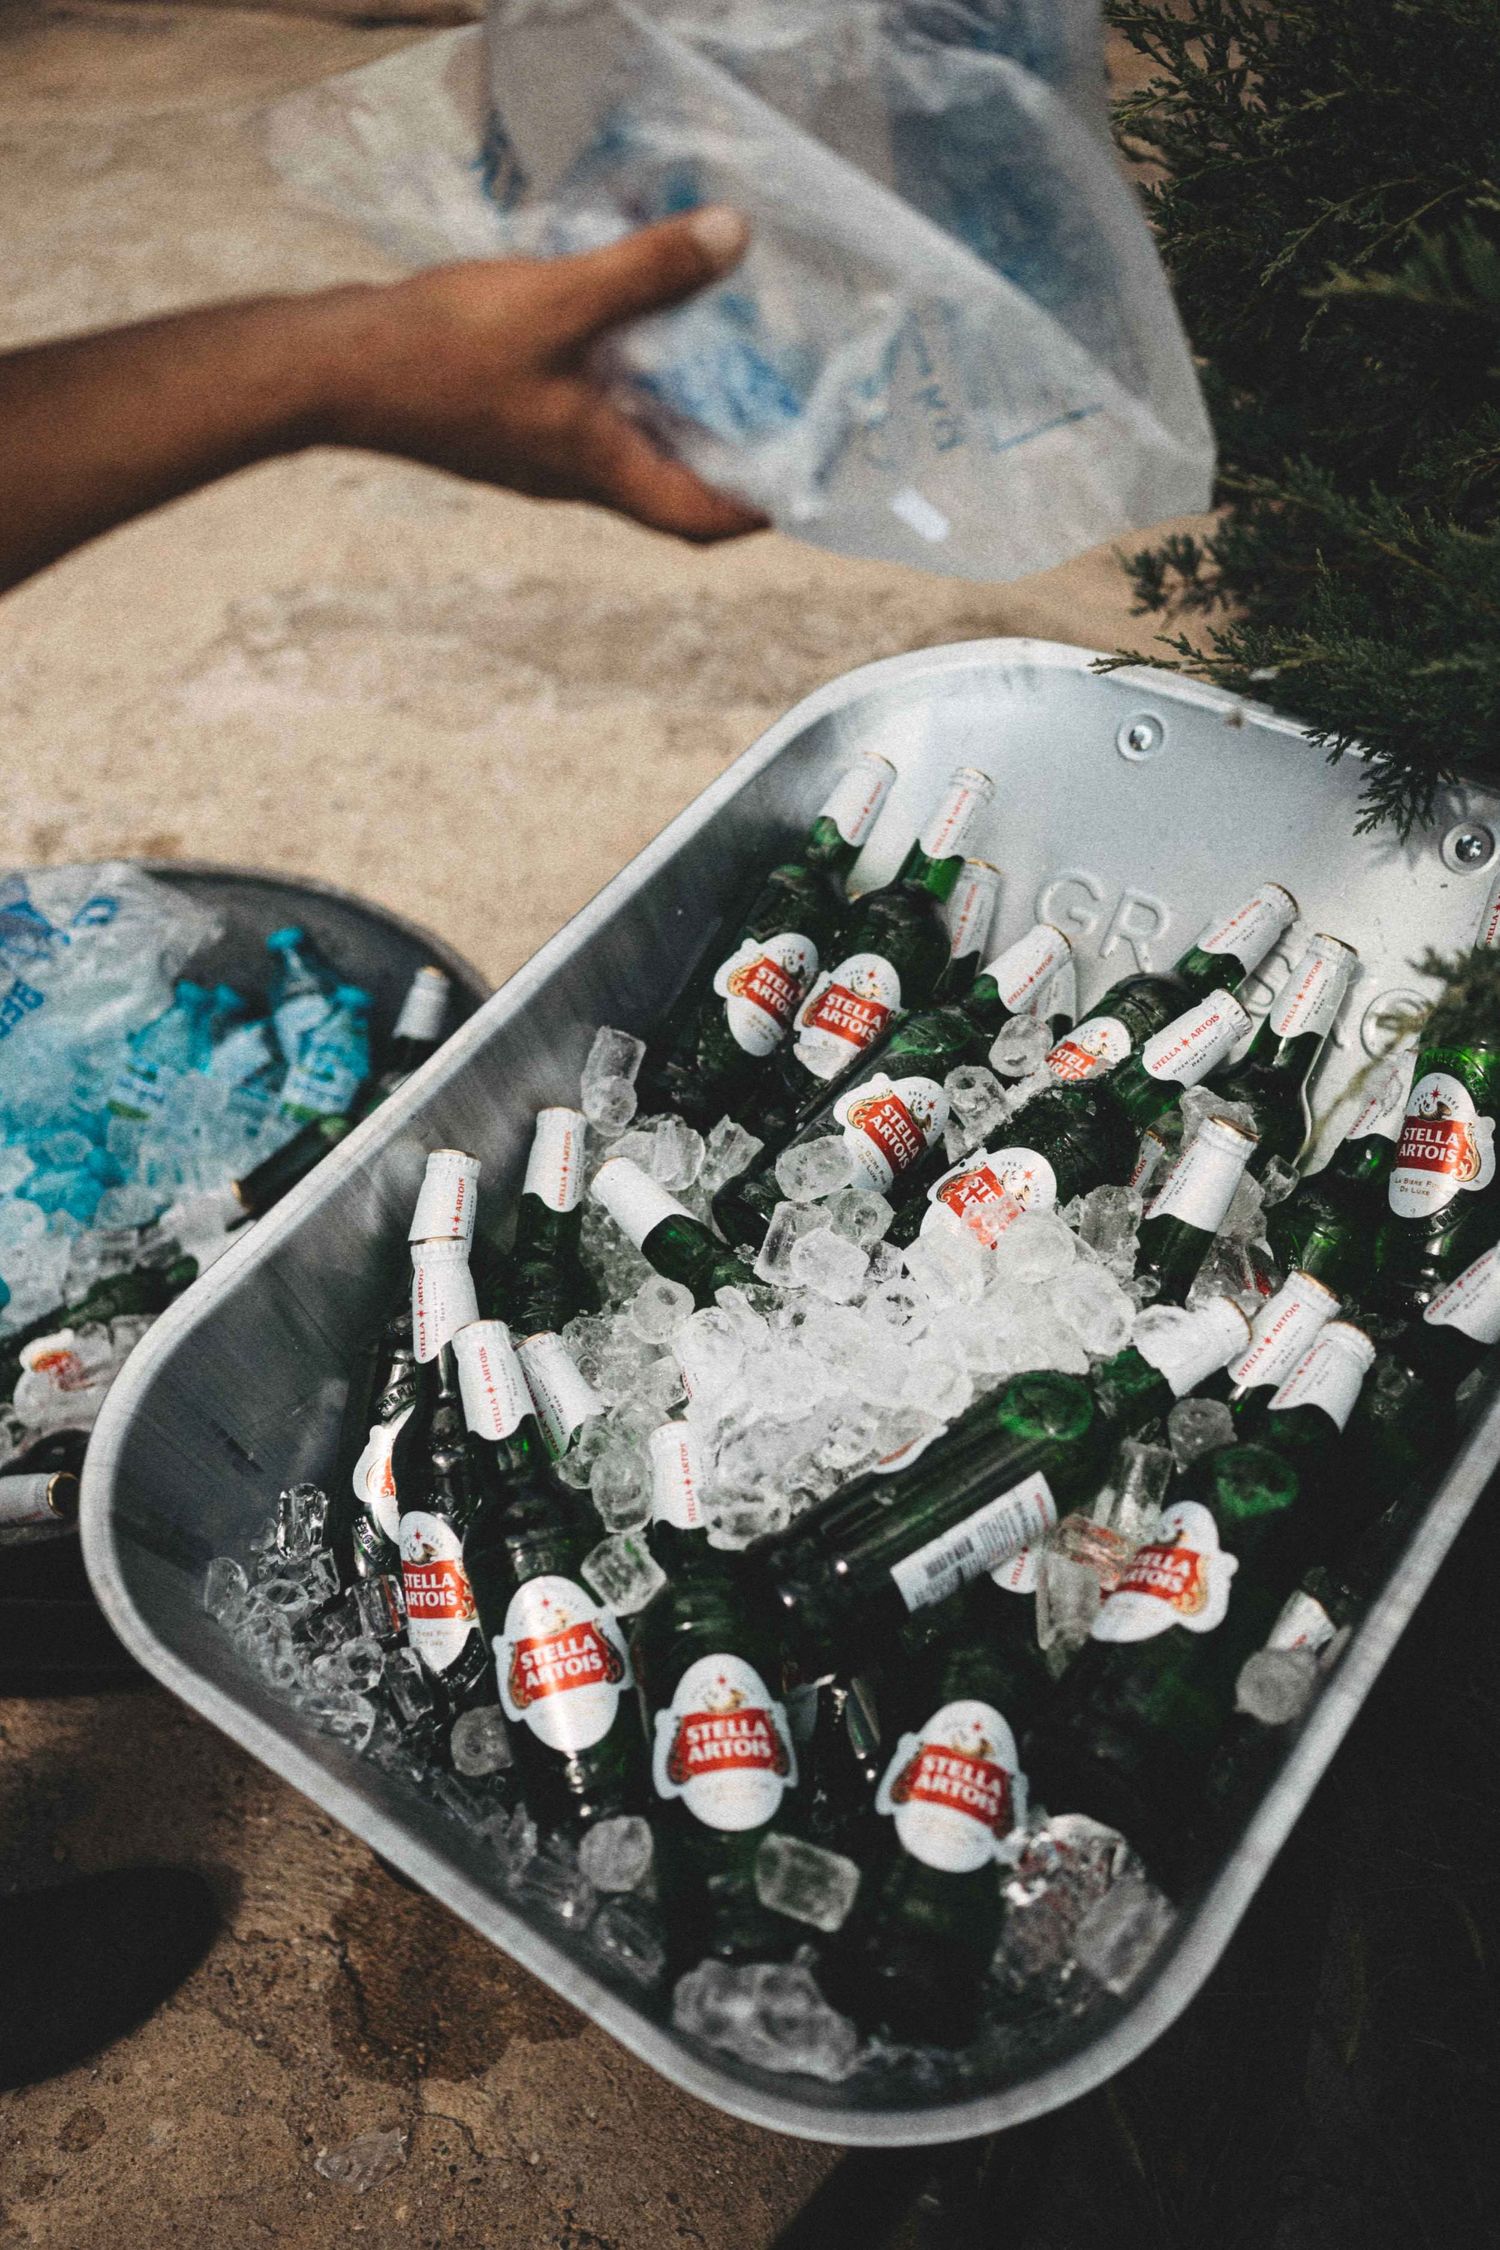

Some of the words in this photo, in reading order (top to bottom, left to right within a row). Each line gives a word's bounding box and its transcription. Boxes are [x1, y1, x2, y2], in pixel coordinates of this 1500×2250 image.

[825, 993, 881, 1028] STELLA
[1280, 1003, 1300, 1033] STELLA
[1302, 960, 1323, 991] ARTOIS
[817, 1008, 878, 1042] ARTOIS
[1152, 1045, 1182, 1072] STELLA
[1190, 1013, 1221, 1041] ARTOIS
[869, 1116, 910, 1170] ARTOIS
[879, 1103, 921, 1161] STELLA
[1404, 1127, 1459, 1146] STELLA
[1398, 1143, 1459, 1163] ARTOIS
[456, 1177, 465, 1213] ARTOIS
[559, 1176, 568, 1207] STELLA
[419, 1322, 427, 1358] STELLA
[1238, 1346, 1265, 1379] STELLA
[1271, 1302, 1301, 1335] ARTOIS
[479, 1346, 493, 1382] ARTOIS
[490, 1398, 504, 1434] STELLA
[520, 1633, 598, 1671] STELLA
[525, 1651, 603, 1690] ARTOIS
[685, 1718, 768, 1744] STELLA
[687, 1738, 772, 1764] ARTOIS
[913, 1773, 1000, 1816] ARTOIS
[921, 1755, 1002, 1800] STELLA
